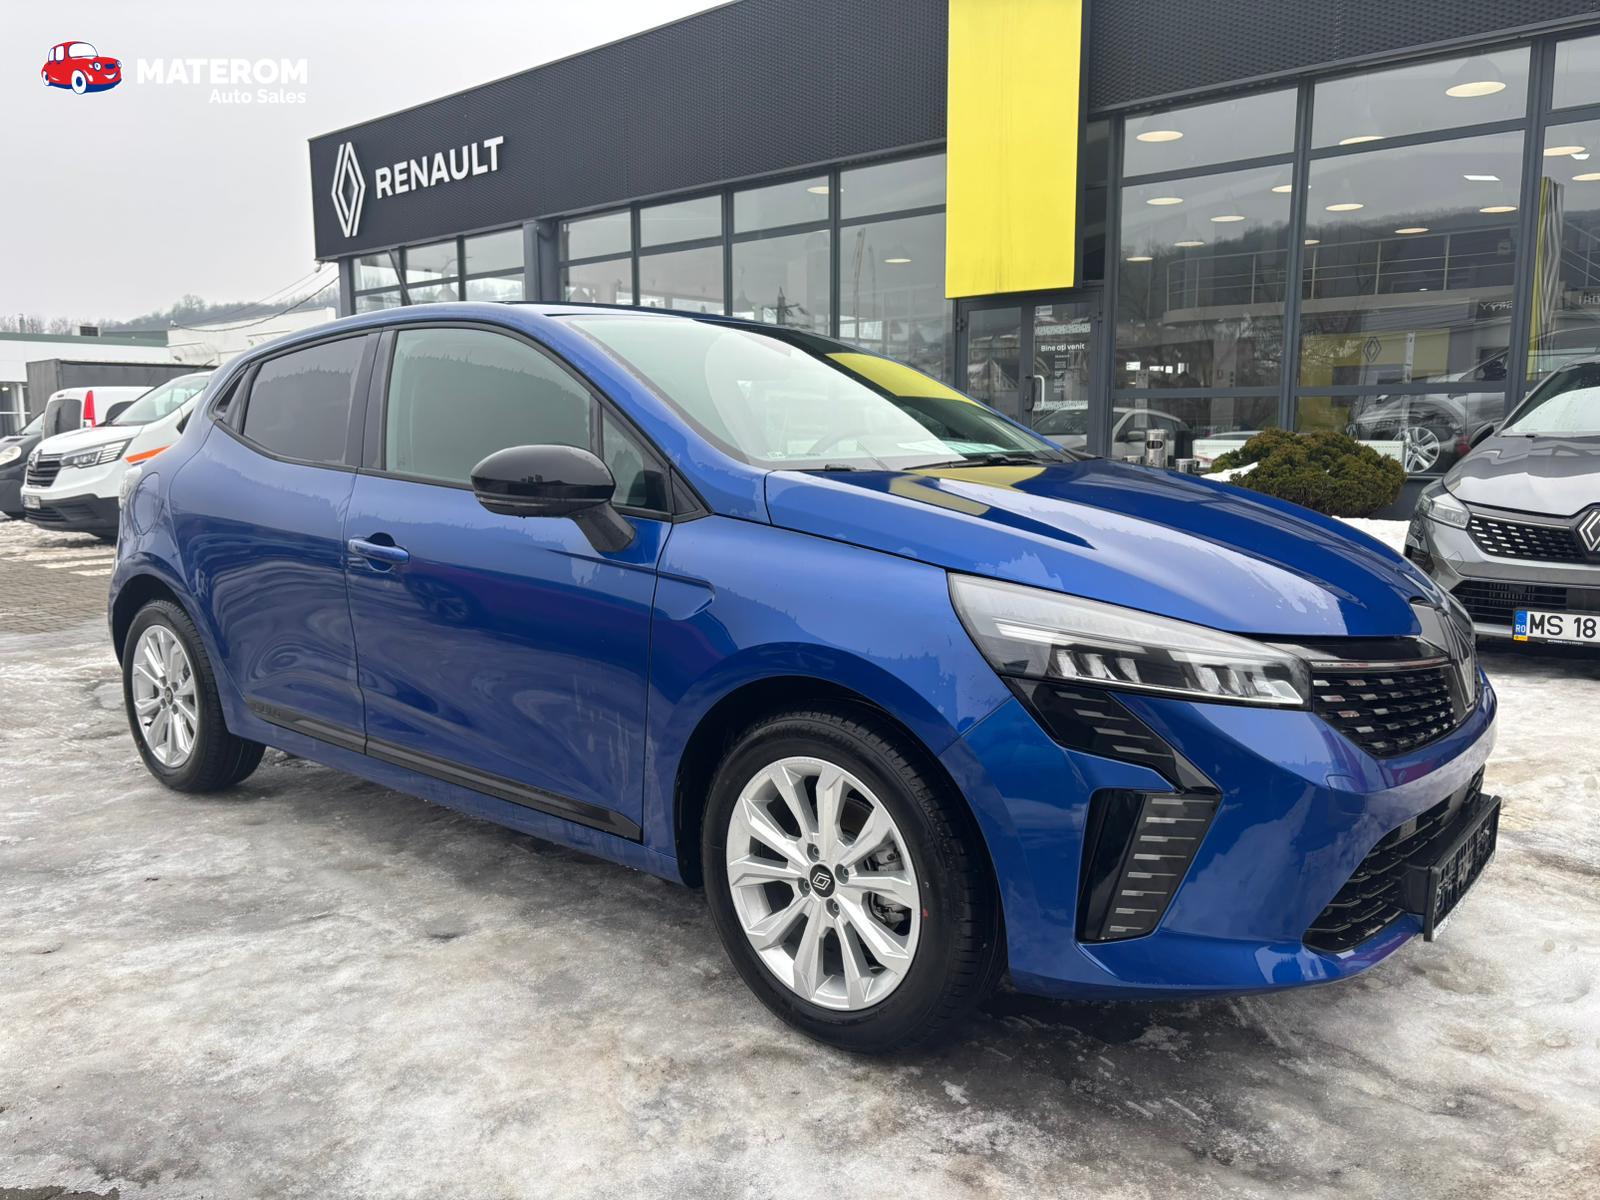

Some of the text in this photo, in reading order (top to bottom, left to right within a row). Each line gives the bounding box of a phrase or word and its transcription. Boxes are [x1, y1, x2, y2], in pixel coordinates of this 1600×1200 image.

[375, 136, 504, 199] RENAULT
[1040, 344, 1056, 352] Bine
[1067, 342, 1085, 350] venit
[1515, 613, 1597, 638] RO MS 18
